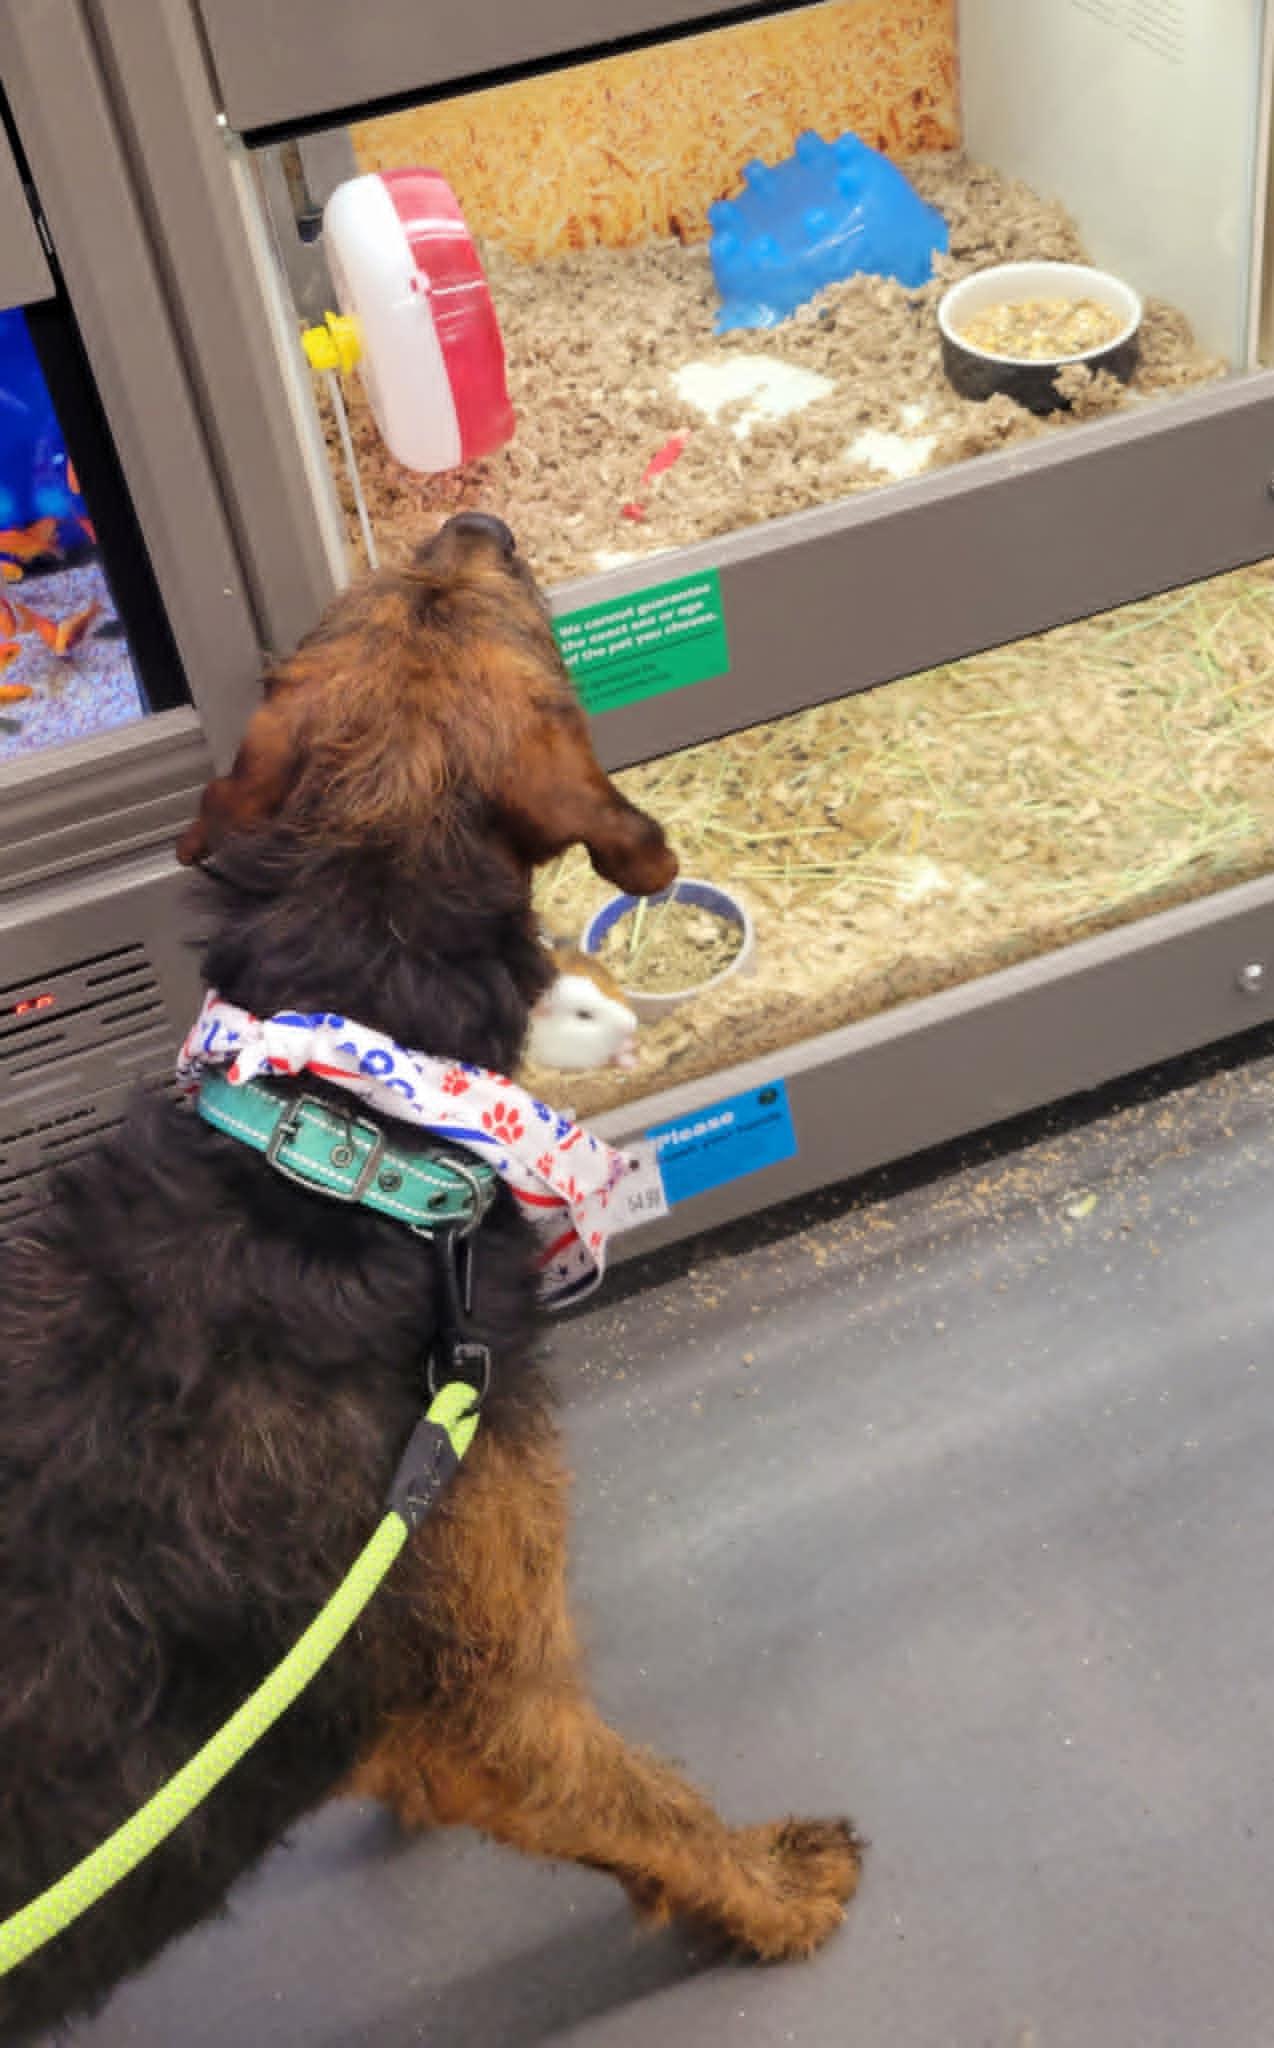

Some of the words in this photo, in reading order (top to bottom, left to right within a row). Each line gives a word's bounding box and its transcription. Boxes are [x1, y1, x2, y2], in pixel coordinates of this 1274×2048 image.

[584, 607, 635, 631] cannot
[636, 584, 712, 616] guarantee
[580, 647, 607, 661] the
[655, 1111, 736, 1152] Please
